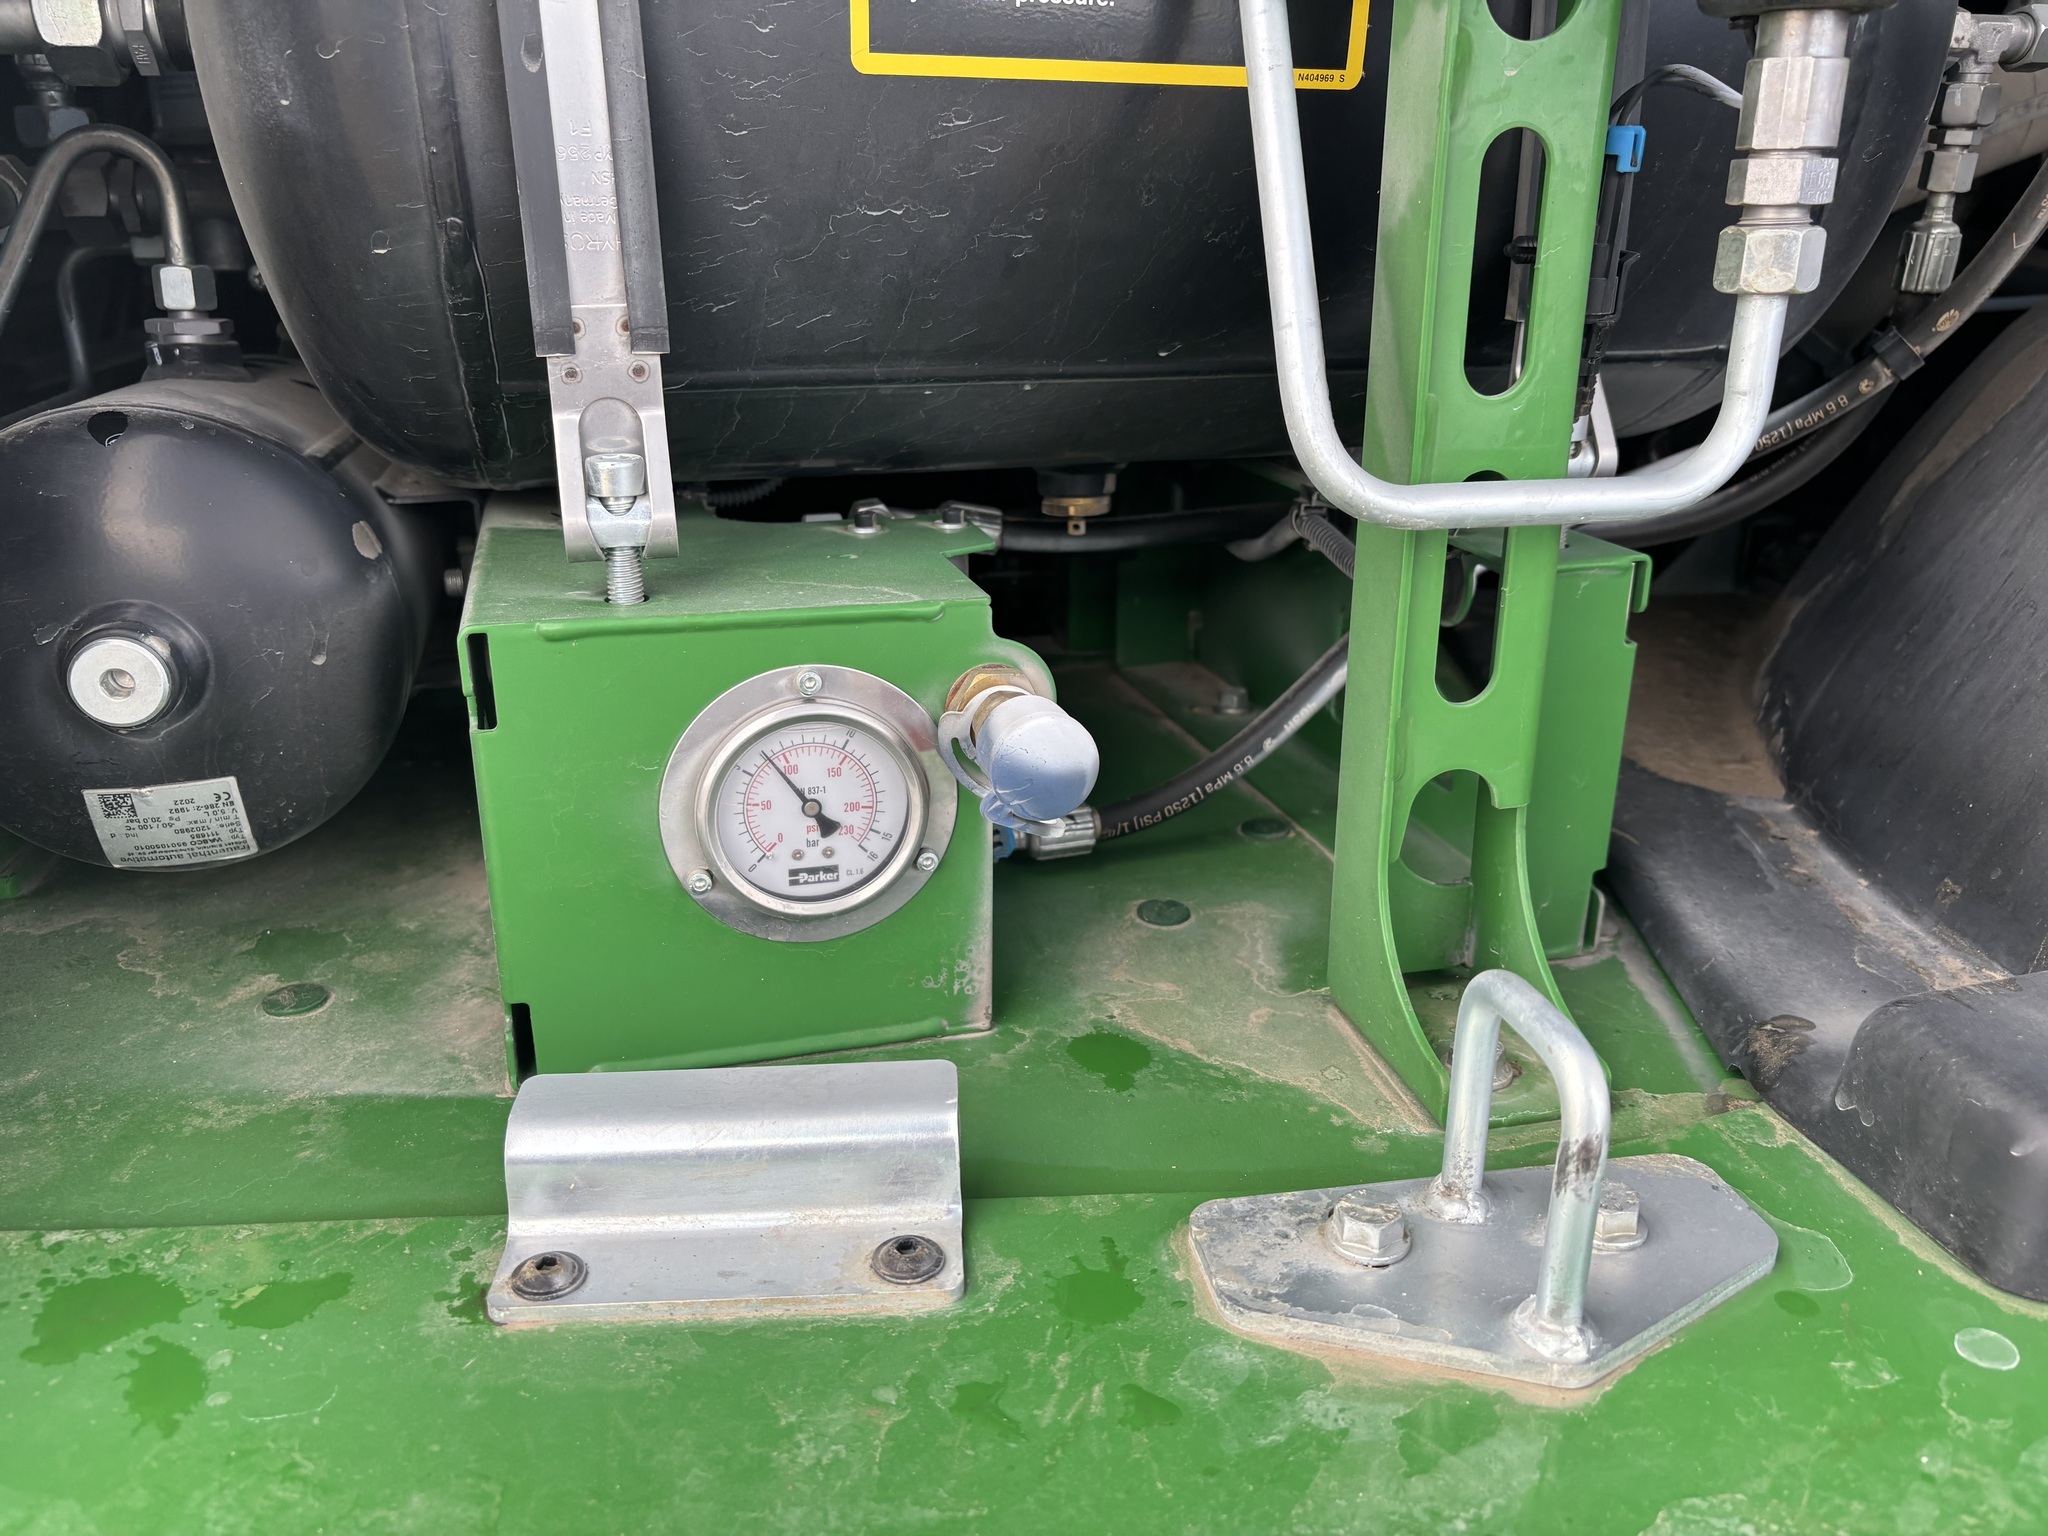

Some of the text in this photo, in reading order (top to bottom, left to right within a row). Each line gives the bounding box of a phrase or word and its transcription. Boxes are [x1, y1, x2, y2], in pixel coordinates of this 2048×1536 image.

[1297, 73, 1346, 83] N404969 S
[569, 119, 592, 137] F1
[555, 144, 592, 161] 256
[560, 192, 618, 209] Germany
[563, 211, 616, 225] Made in
[1795, 409, 1825, 430] MPa
[783, 764, 799, 775] 100
[827, 766, 842, 778] 150
[1204, 770, 1234, 793] MPa
[807, 785, 826, 795] 837-1
[173, 798, 196, 806] 2022
[761, 800, 772, 811] 50
[844, 801, 860, 813] 200
[838, 824, 854, 836] 230
[190, 837, 223, 846] WABCO
[777, 832, 783, 843] 0
[881, 831, 893, 841] 15
[806, 838, 820, 848] bar
[120, 853, 184, 863] automotive
[867, 851, 879, 861] 16
[748, 863, 757, 873] 0
[799, 870, 839, 884] Parker
